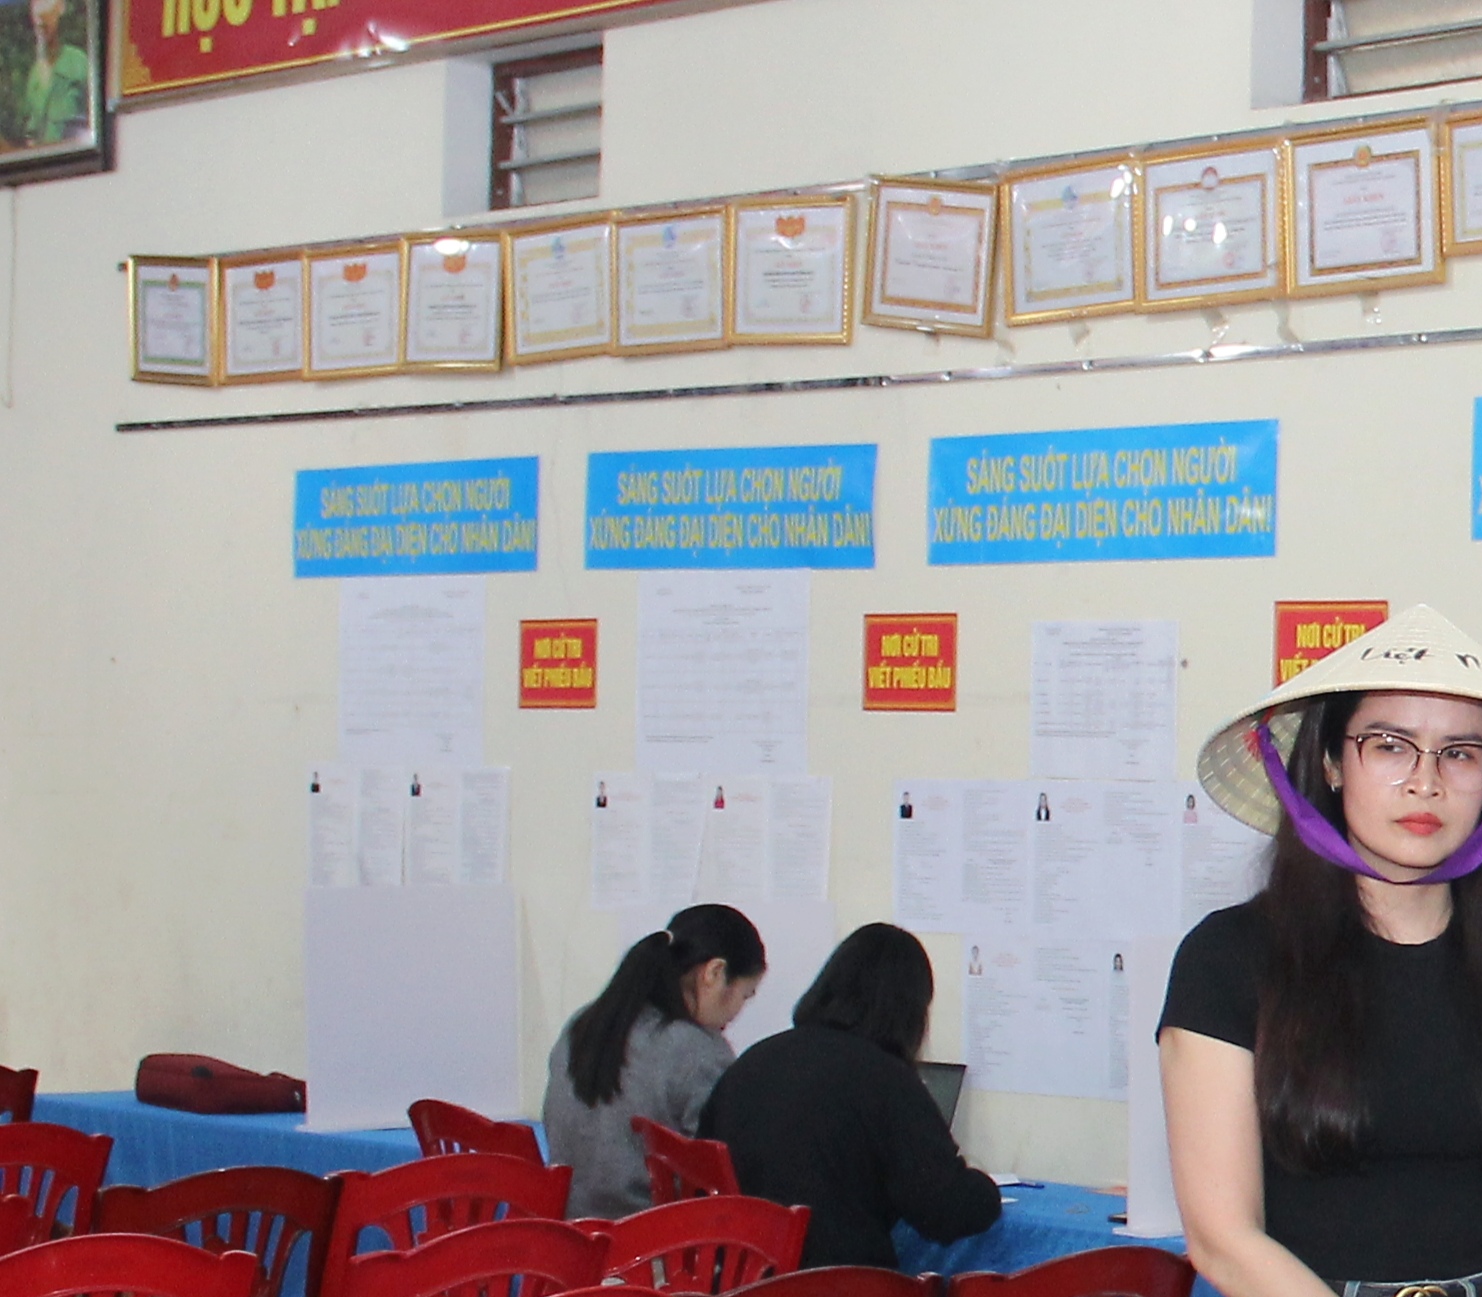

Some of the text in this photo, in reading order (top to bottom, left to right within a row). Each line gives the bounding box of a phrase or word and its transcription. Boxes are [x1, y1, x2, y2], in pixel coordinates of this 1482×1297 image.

[619, 464, 659, 505] SÁNG
[706, 469, 738, 511] LỰA
[741, 468, 785, 510] CHỌN
[788, 458, 842, 501] NGƯỜI
[967, 437, 1237, 497] SÁNG SUỐT LỰA CHỌN NGƯỜI
[590, 510, 632, 548] XỨNG
[633, 509, 677, 548] ĐÁNG
[678, 515, 706, 556] ĐẠI
[748, 514, 781, 547] CHO
[783, 505, 829, 546] NHÂN
[832, 505, 874, 545] DÂN!
[934, 487, 1275, 548] XỨNG ĐÁNG ĐẠI DIỆN CHO NHÂN DÂN!
[881, 627, 938, 657] NƠI CỬ TRI
[1296, 622, 1320, 648] NƠI
[1322, 616, 1344, 648] CỬ
[868, 659, 892, 689] VIẾT
[892, 659, 926, 689] PHIẾU
